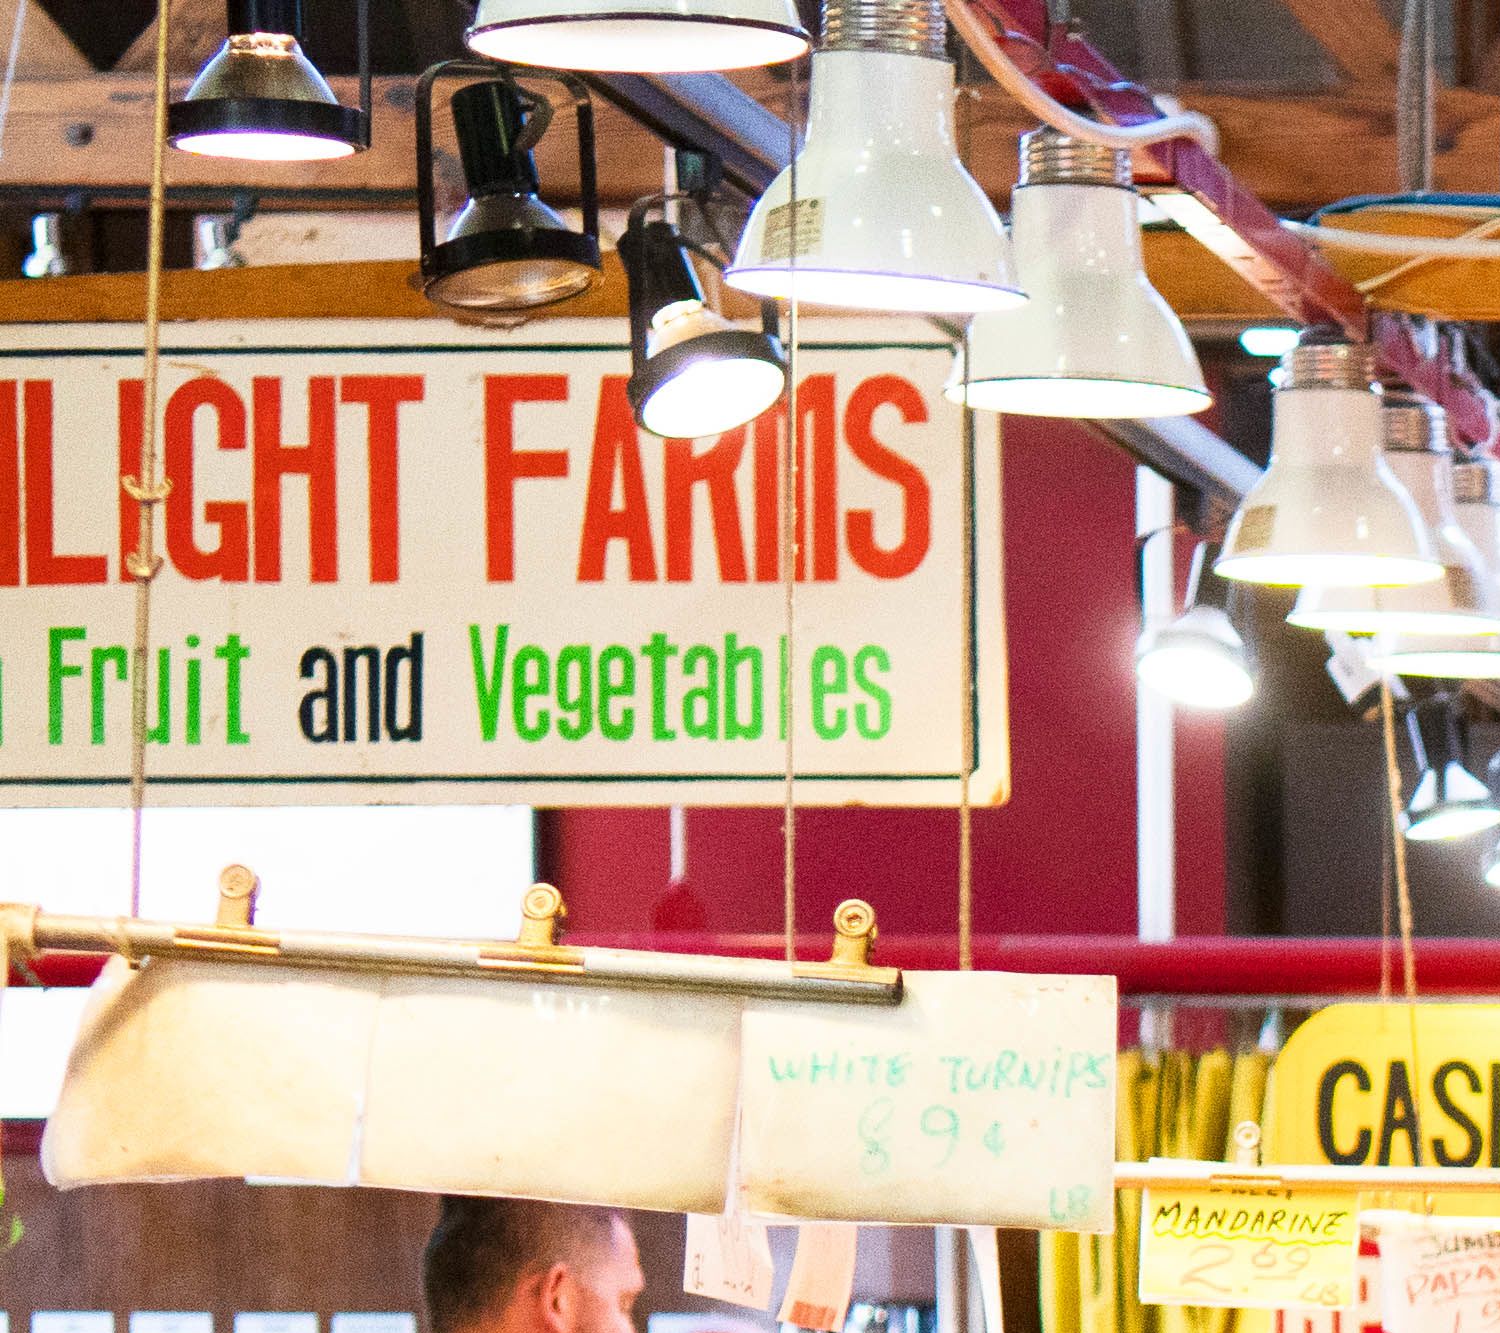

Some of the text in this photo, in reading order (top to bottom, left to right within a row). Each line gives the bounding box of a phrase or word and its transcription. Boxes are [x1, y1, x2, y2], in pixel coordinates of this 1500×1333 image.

[0, 373, 931, 584] LIGHT FARMS
[47, 625, 891, 746] Fruit and Vegetables
[768, 1044, 1111, 1099] WHITE TURNIPS
[1049, 1185, 1093, 1222] LB
